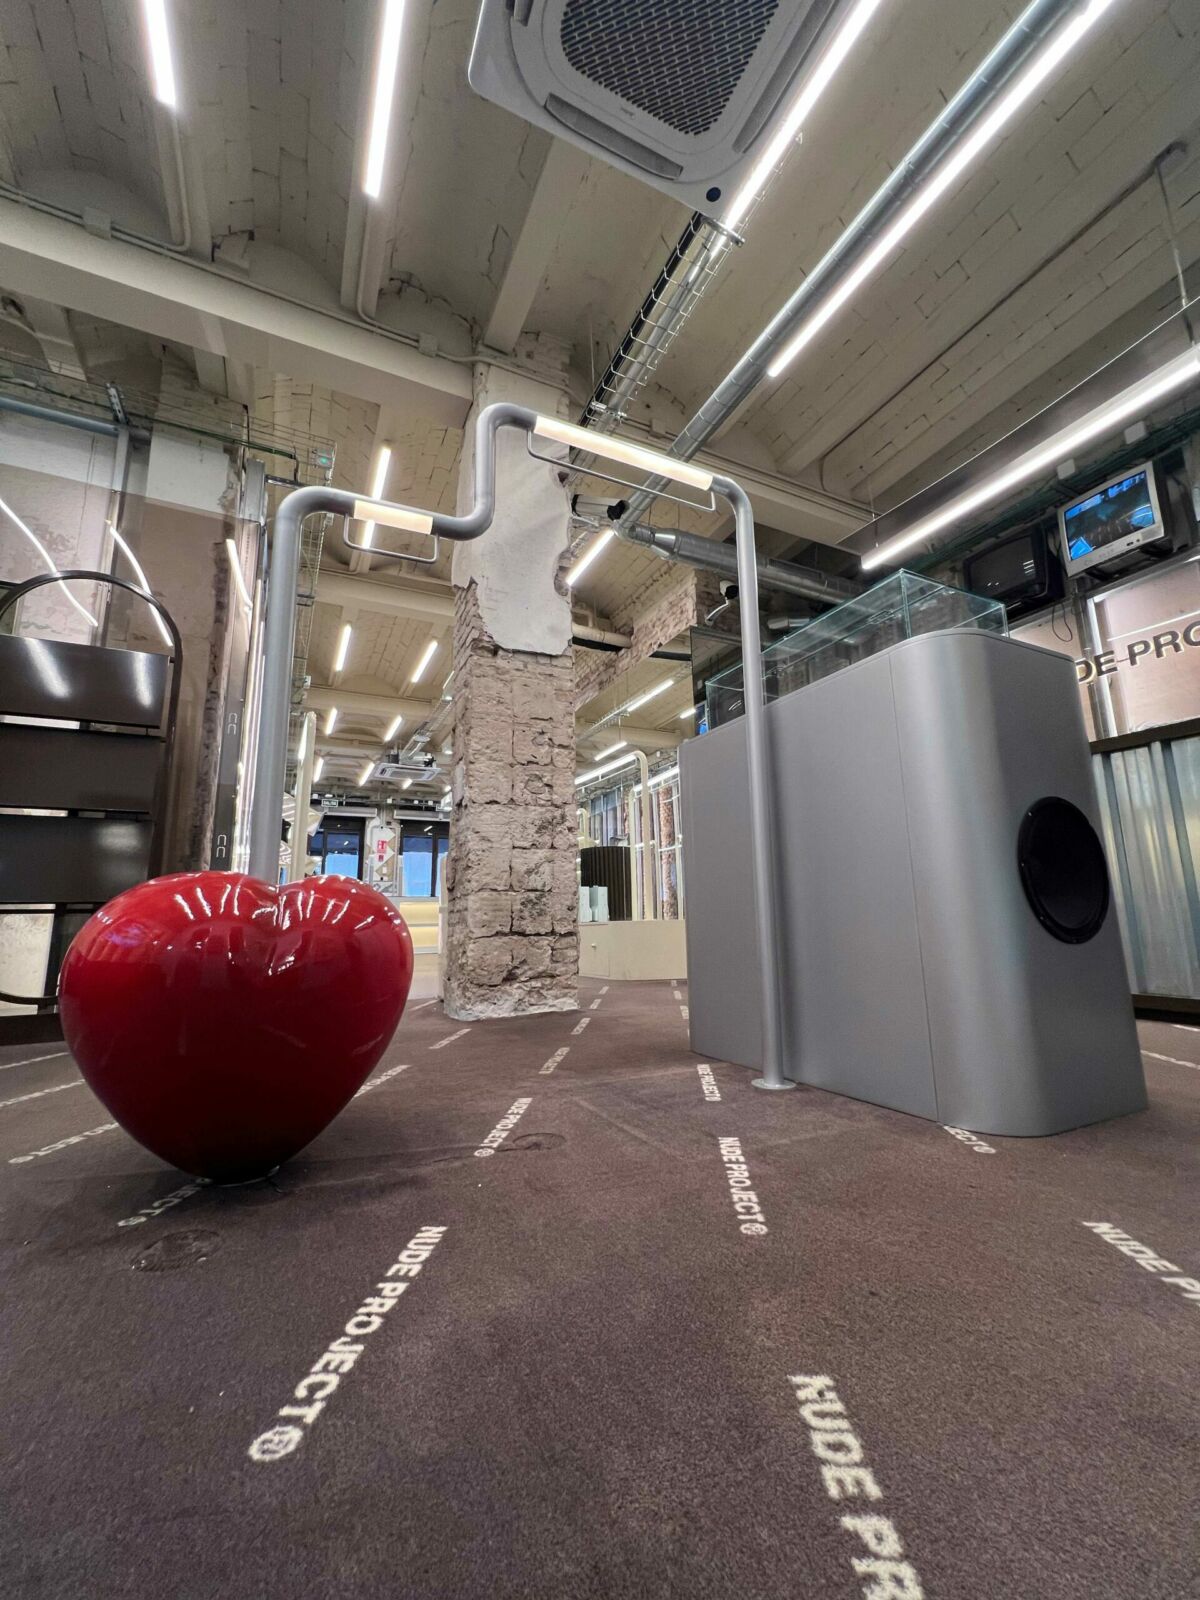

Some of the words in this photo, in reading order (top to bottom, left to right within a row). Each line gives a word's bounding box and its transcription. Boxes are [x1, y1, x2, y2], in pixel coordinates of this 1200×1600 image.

[718, 1137, 746, 1162] NUDE
[386, 1226, 448, 1277] NUDE
[1081, 1222, 1183, 1273] NUDE
[787, 1374, 883, 1501] NUDE
